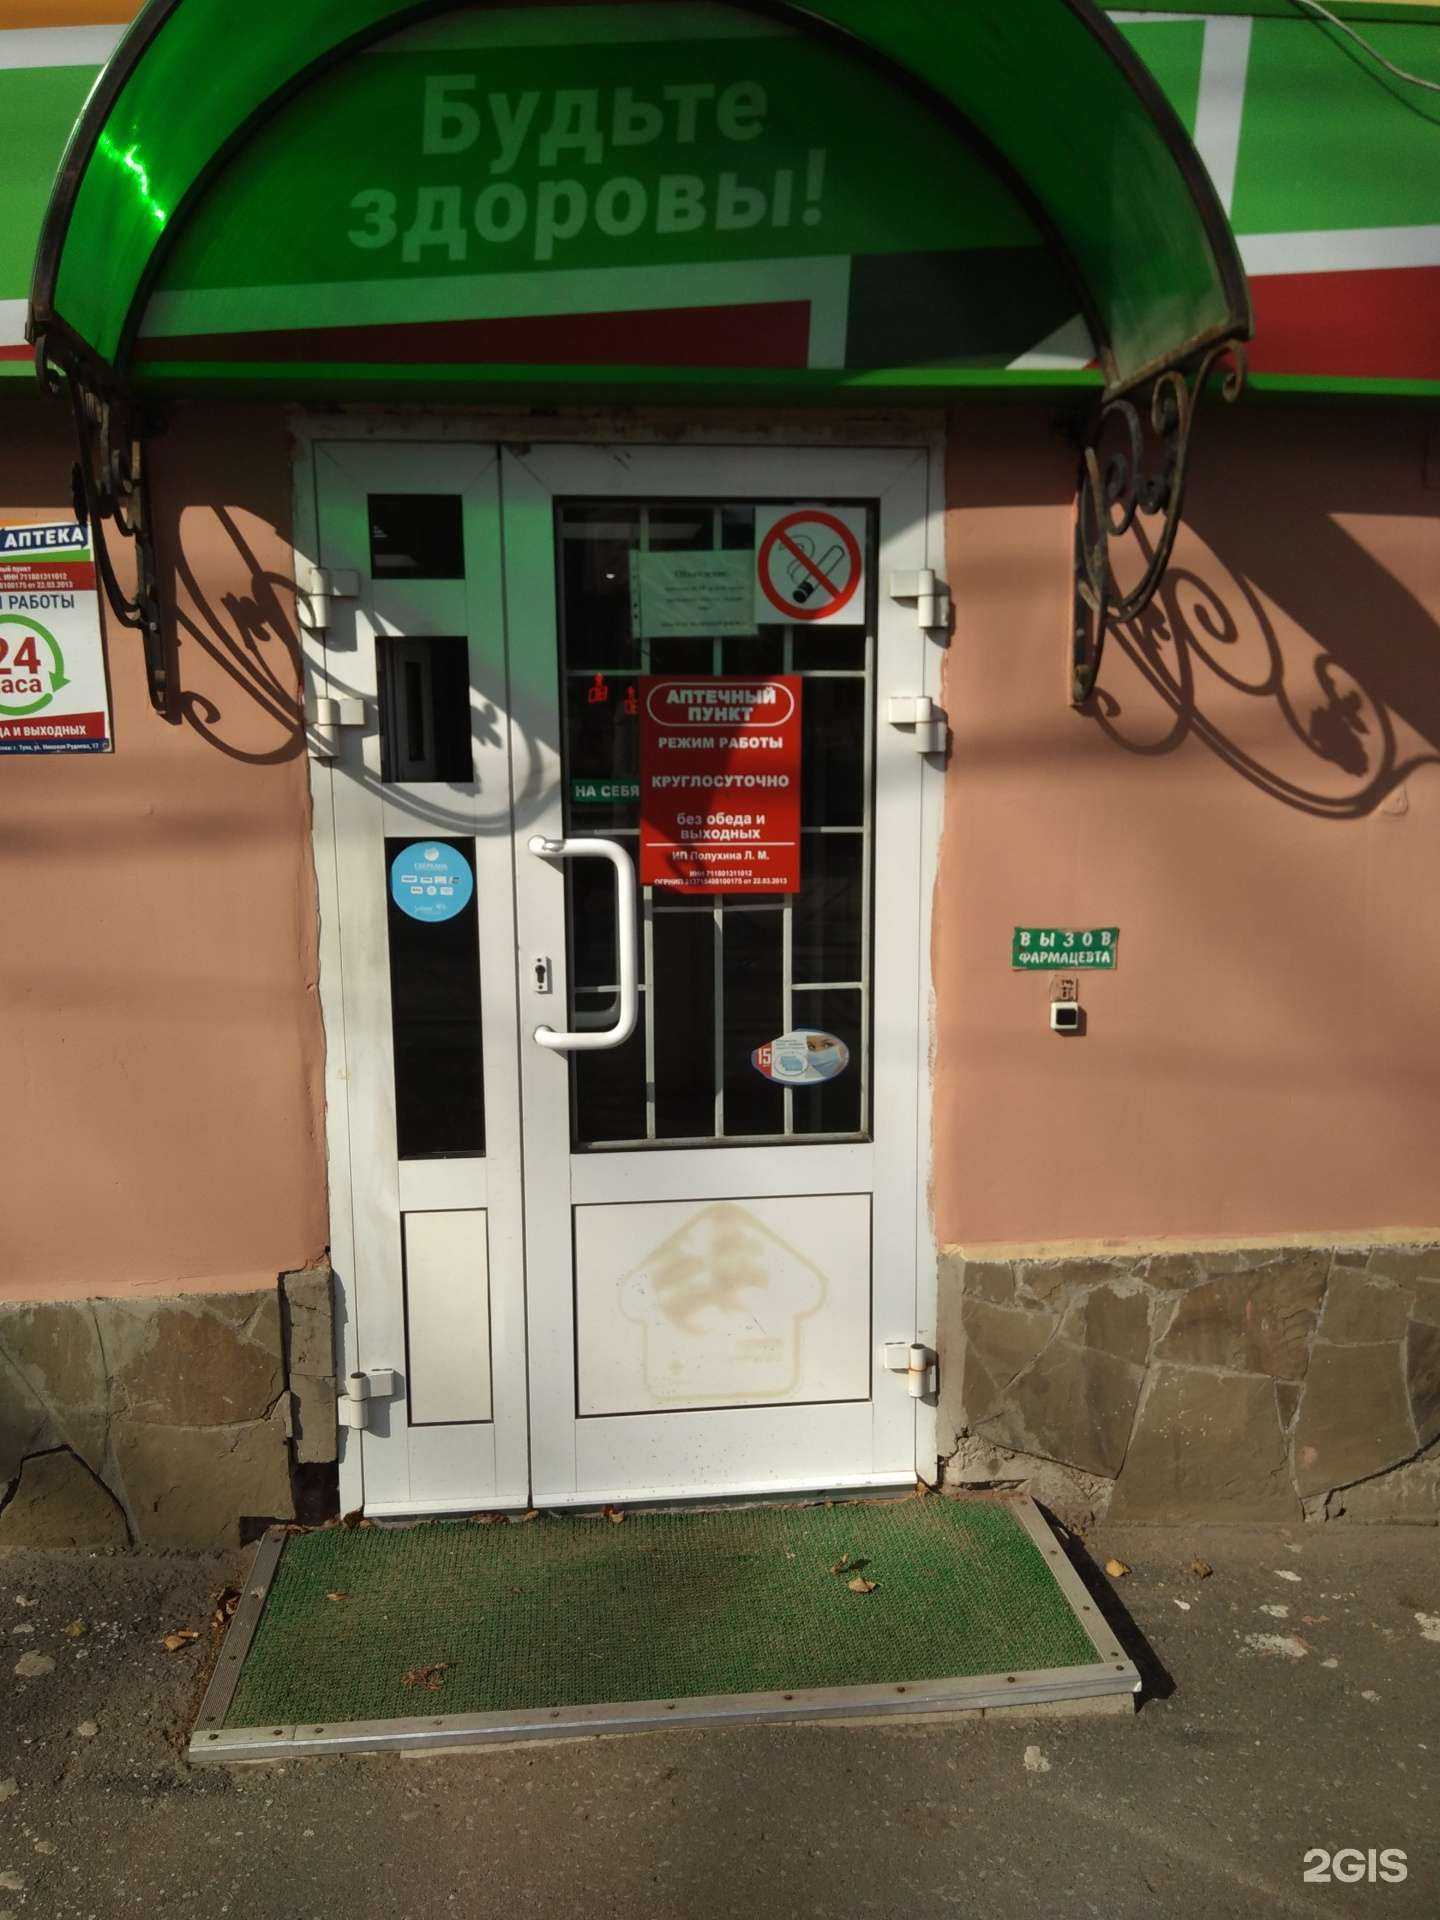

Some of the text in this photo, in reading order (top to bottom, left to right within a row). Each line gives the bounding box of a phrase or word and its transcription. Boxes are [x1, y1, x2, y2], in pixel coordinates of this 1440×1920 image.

[422, 74, 769, 174] Будьте
[348, 149, 826, 262] здоровы!
[4, 526, 84, 548] АПТЕКА
[9, 594, 75, 609] РАБОТЫ
[0, 678, 42, 693] аса
[666, 686, 776, 705] АПТЕЧНЫЙ
[688, 707, 754, 722] ПУНКТ
[13, 727, 21, 736] И
[23, 725, 87, 737] ВЫХОДНЫХ
[658, 737, 783, 748] РЕЖИМ РАБОТЫ
[652, 775, 790, 788] КРУГЛОСУТОЧНО
[575, 785, 640, 797] НА СЕБЯ
[676, 812, 765, 827] без обеда и
[680, 829, 761, 841] выходных
[672, 850, 770, 862] ИП Полухина Л. М.
[1019, 950, 1111, 966] ФАРМАЦЕВТА
